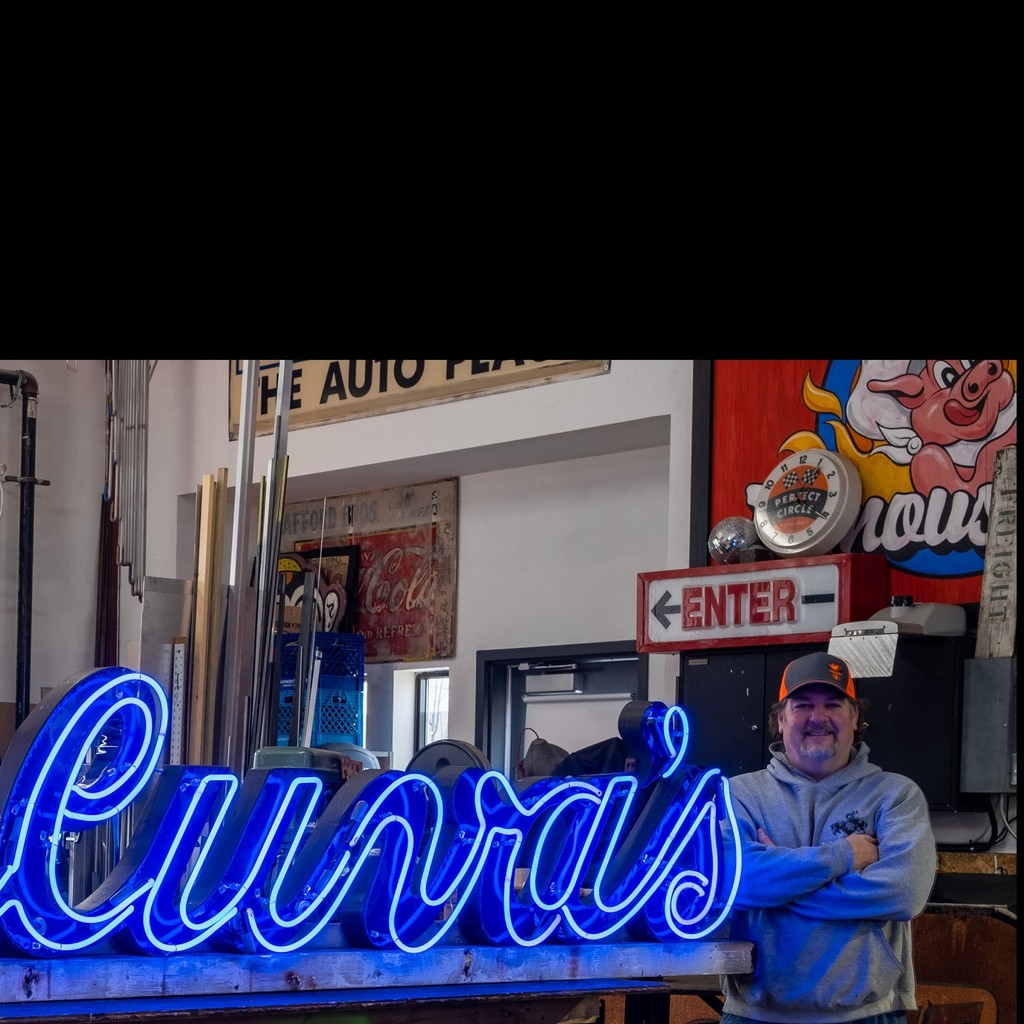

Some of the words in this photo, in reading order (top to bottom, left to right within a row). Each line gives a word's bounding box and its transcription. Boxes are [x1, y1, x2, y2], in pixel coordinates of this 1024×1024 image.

[258, 369, 302, 415] HE
[319, 360, 426, 404] AUTO
[777, 504, 814, 518] CIRCLE
[988, 488, 1017, 623] FREIGHT
[681, 578, 796, 630] ENTER
